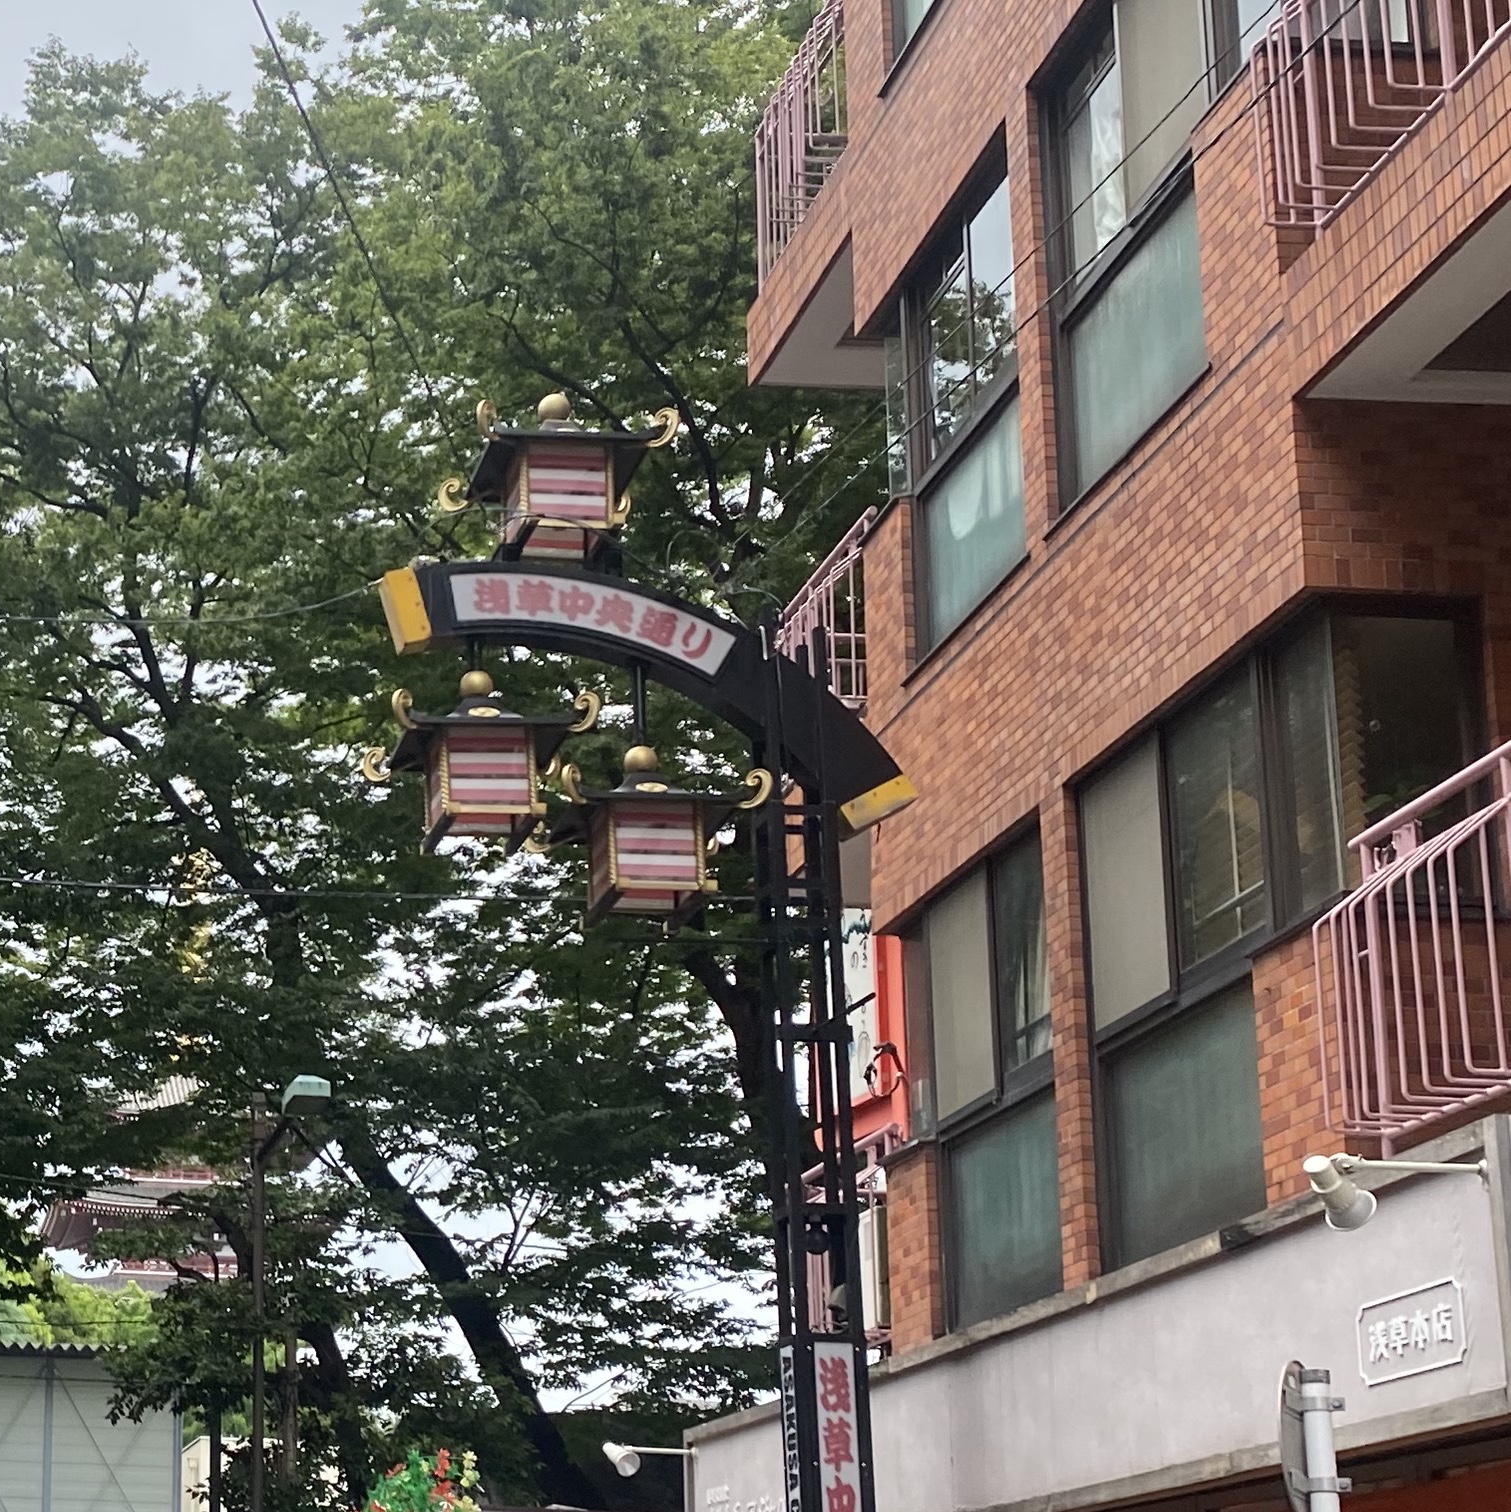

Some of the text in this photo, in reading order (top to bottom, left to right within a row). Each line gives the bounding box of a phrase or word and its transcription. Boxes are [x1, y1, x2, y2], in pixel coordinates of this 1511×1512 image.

[473, 577, 714, 660] 浅草中央通り
[1366, 1301, 1455, 1364] 浅草本店
[782, 1356, 800, 1492] ASAKUSA
